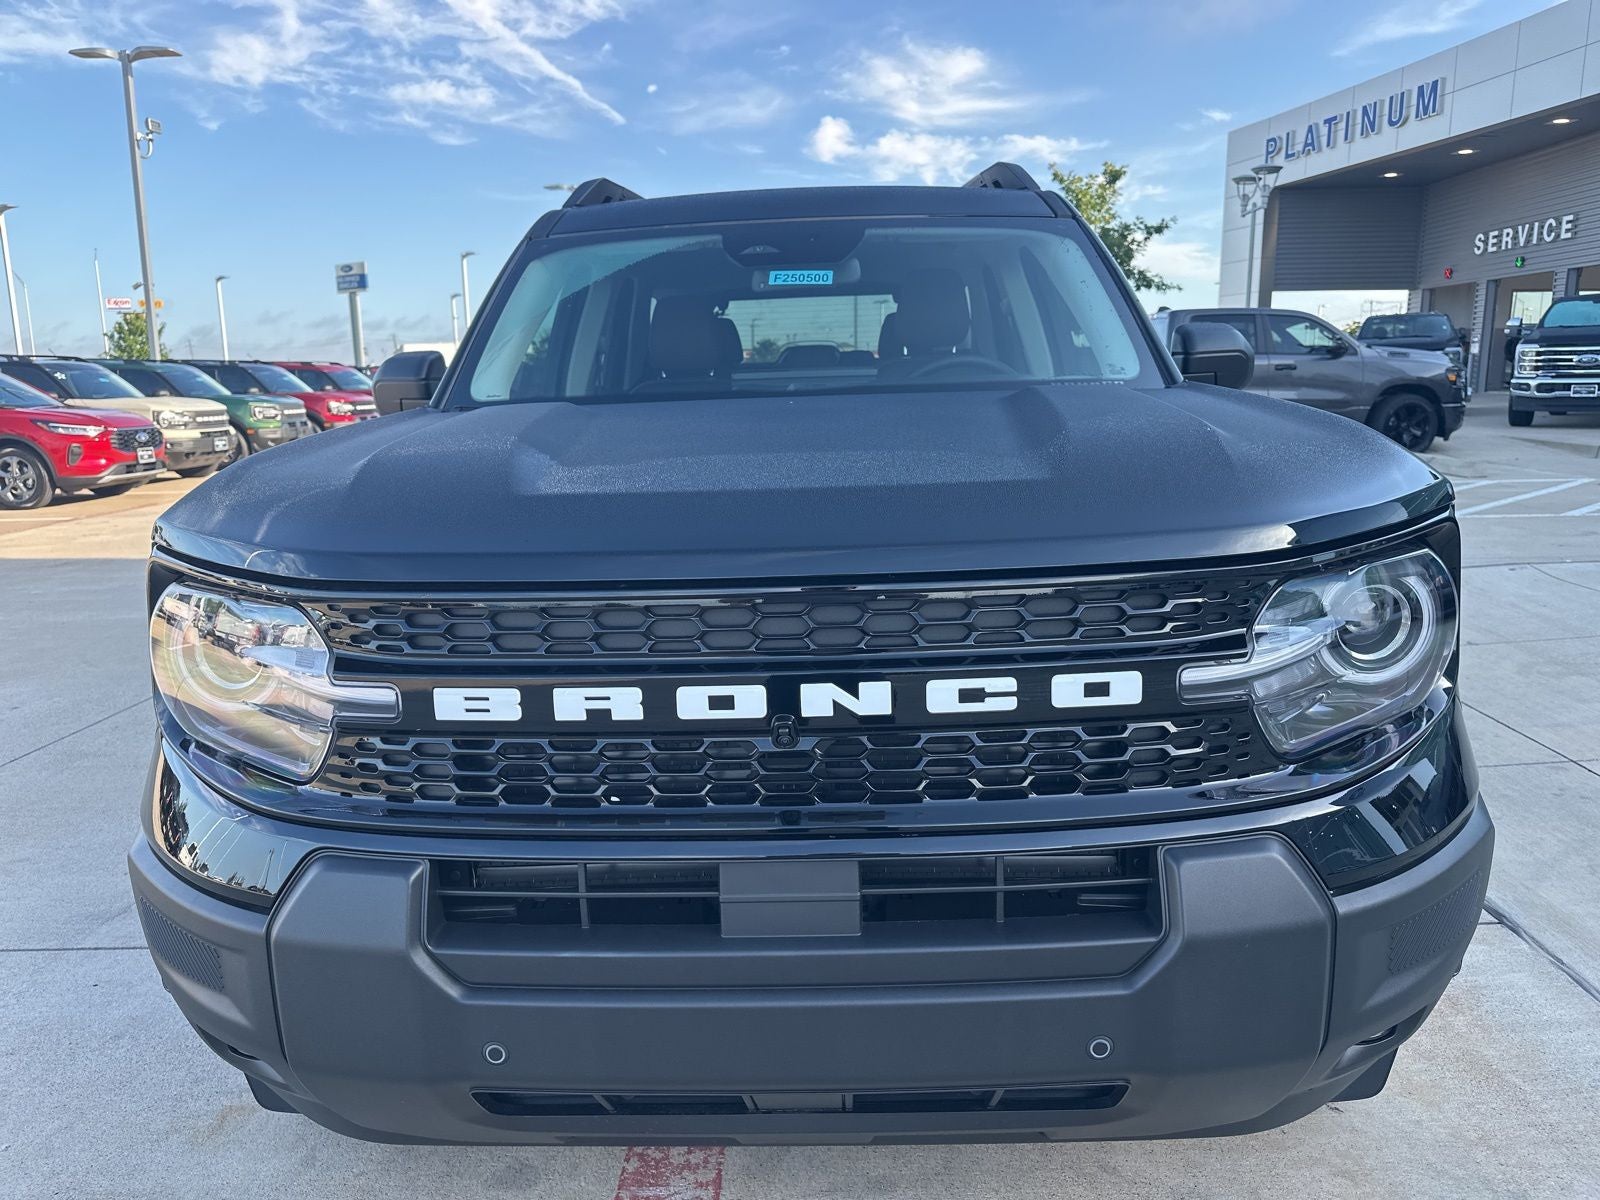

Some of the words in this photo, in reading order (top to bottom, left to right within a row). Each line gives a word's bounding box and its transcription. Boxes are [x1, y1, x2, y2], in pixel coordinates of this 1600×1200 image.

[1265, 79, 1443, 164] PLATINUM
[1474, 214, 1574, 255] SERVICE
[774, 273, 829, 283] F250500
[433, 670, 1143, 721] BRONCO
